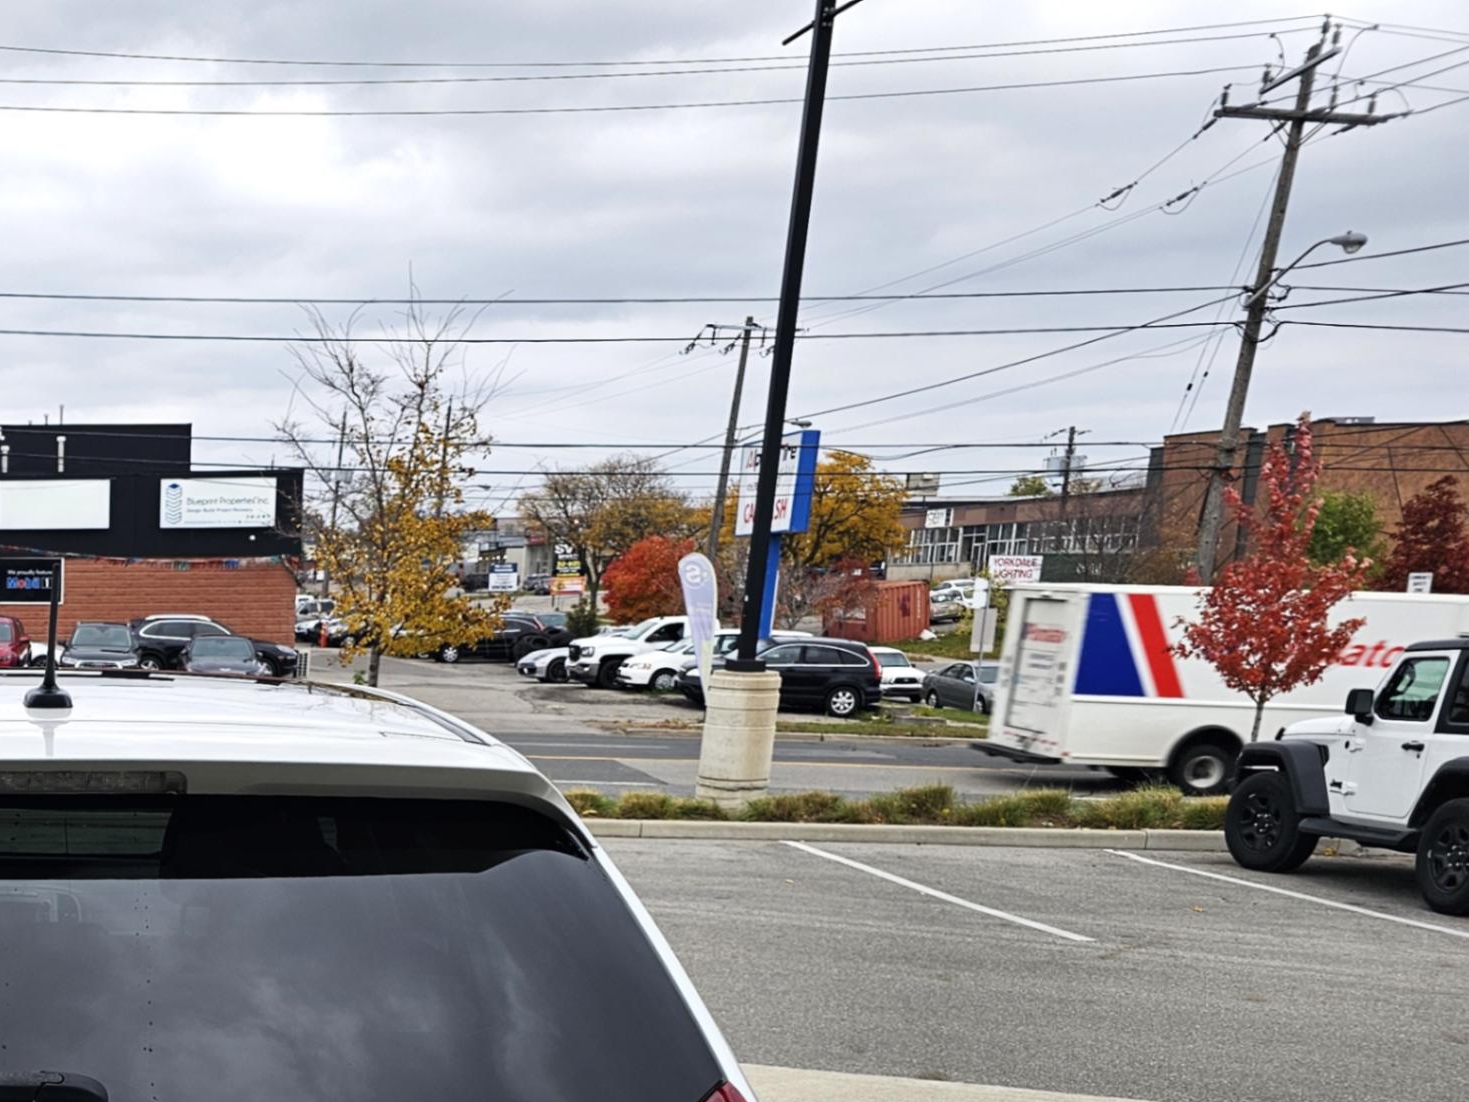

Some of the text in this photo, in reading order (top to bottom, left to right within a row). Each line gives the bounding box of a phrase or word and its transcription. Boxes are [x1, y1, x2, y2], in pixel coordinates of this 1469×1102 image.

[186, 496, 218, 507] Blueprint
[993, 558, 1038, 567] YORKDALE
[994, 569, 1033, 578] LIGHTING
[7, 577, 40, 589] Mobil
